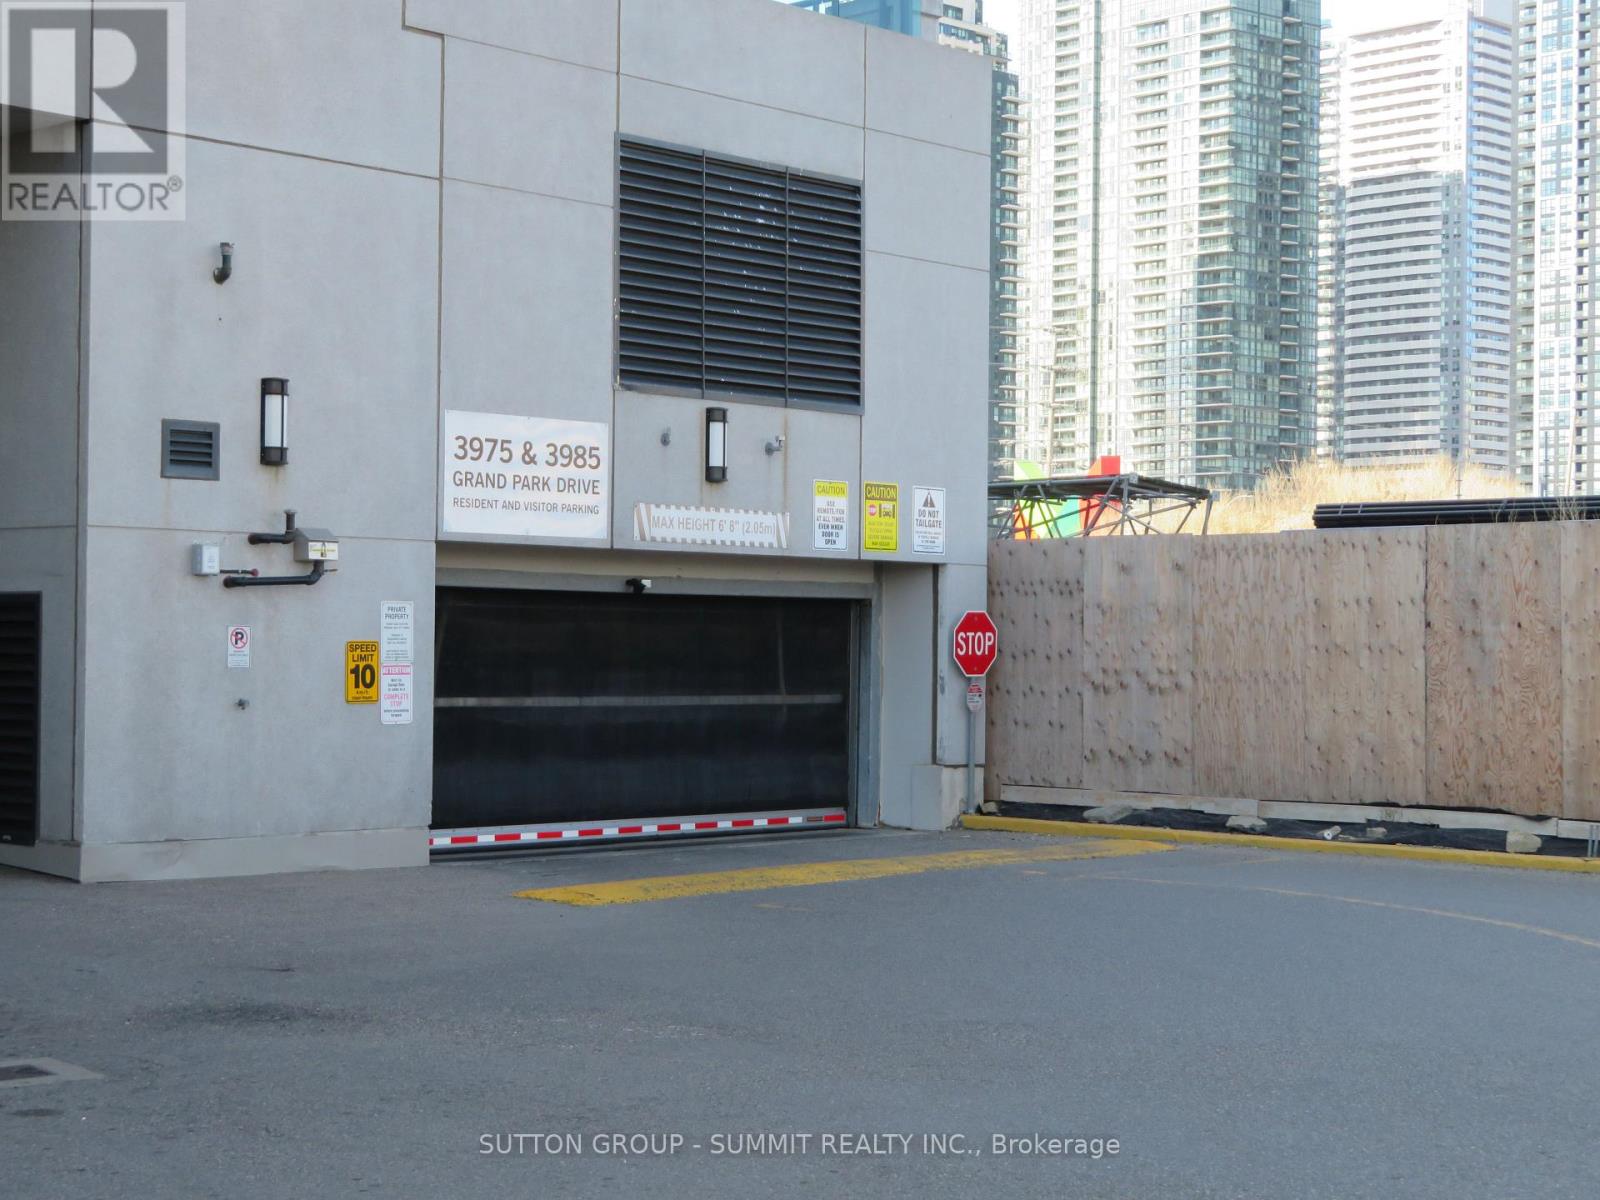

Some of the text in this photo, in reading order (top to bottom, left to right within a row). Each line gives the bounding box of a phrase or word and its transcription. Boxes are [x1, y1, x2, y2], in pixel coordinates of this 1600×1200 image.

[453, 435, 601, 470] 3975 & 3985
[453, 470, 600, 495] GRAND PARK DRIVE
[816, 484, 846, 496] CAUTION
[866, 486, 897, 499] CAUTION
[453, 497, 600, 515] RESIDENT AND VISITOR PARKING
[917, 508, 940, 519] DO NOT
[651, 515, 675, 529] MAX
[677, 517, 716, 532] HEIGHT
[742, 521, 775, 537] (2.05m)
[915, 518, 942, 529] TAILGATE
[349, 643, 377, 653] SPEED
[957, 631, 995, 656] STOP
[351, 653, 375, 663] LIMIT
[349, 663, 376, 689] 10
